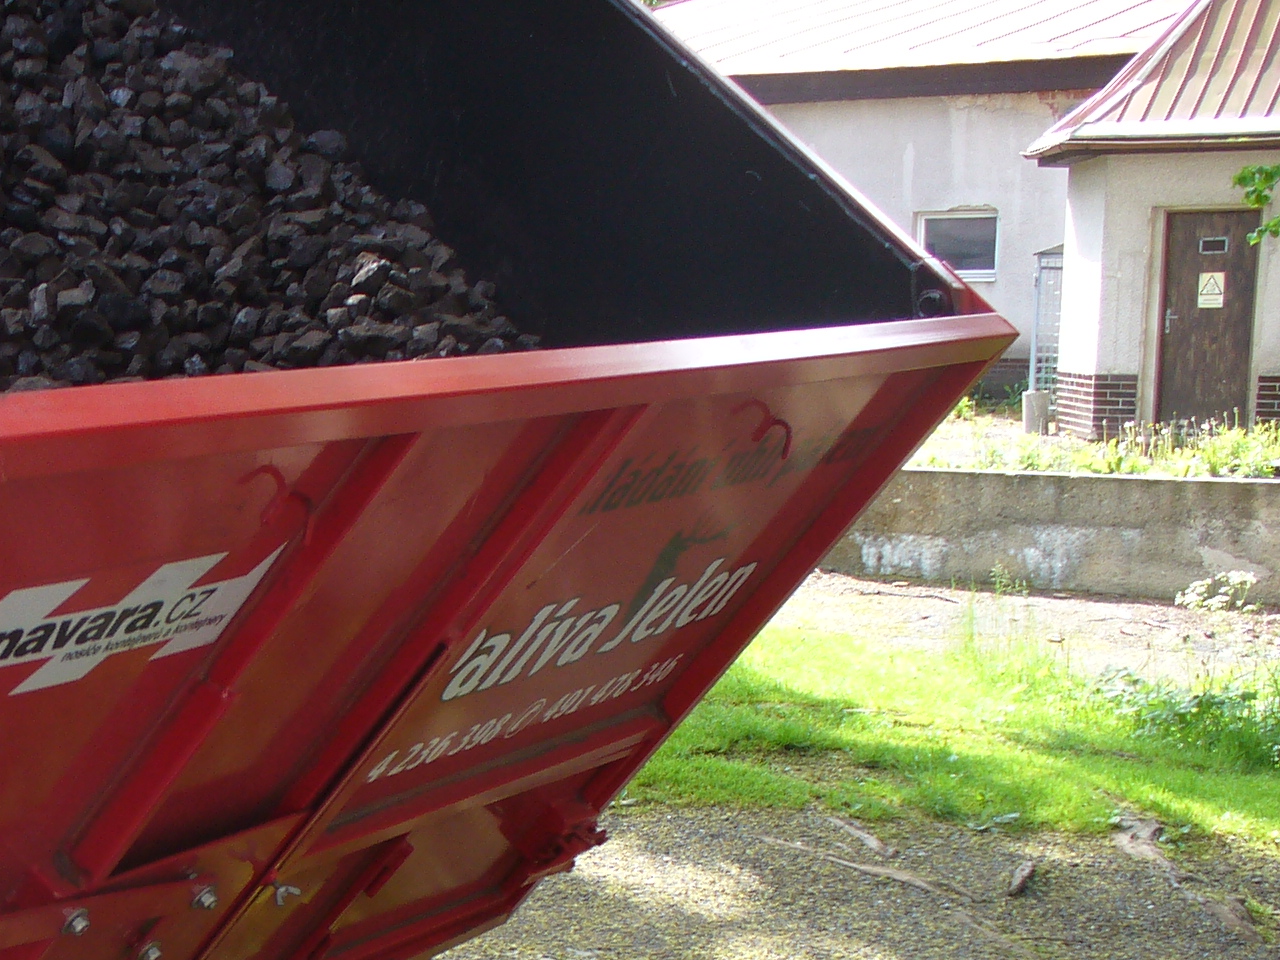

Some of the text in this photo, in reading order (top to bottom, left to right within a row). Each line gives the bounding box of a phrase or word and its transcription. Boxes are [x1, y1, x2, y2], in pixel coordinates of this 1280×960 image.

[598, 557, 759, 655] Jelen
[387, 730, 459, 777] 236
[448, 713, 513, 757] 398
